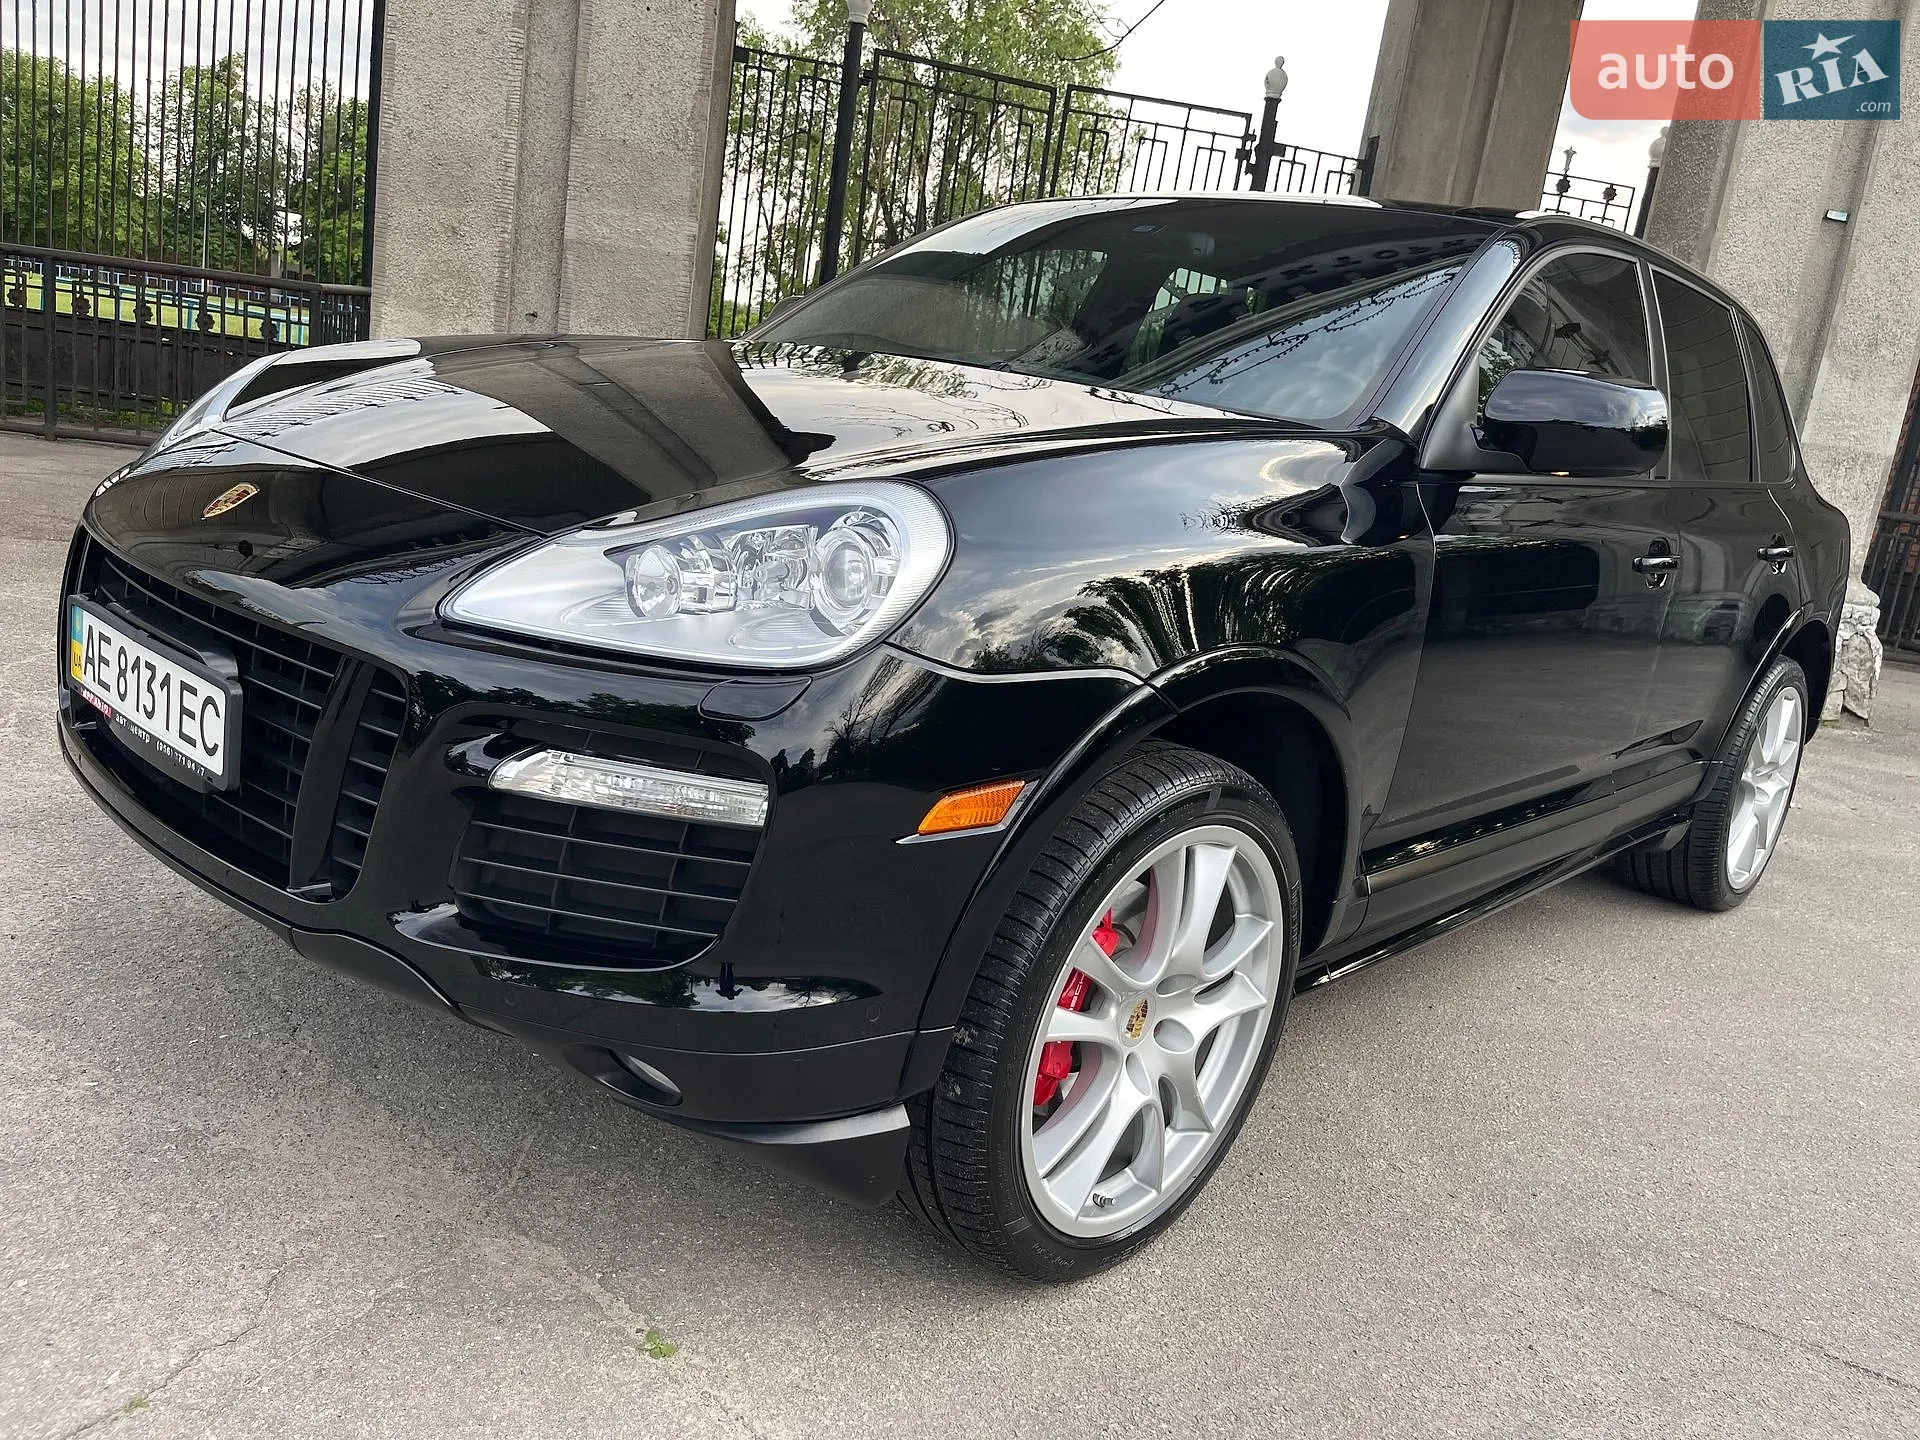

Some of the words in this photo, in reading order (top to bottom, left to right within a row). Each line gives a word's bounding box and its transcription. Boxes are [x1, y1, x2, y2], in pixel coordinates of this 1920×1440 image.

[83, 624, 112, 694] AE
[116, 645, 171, 732] 8131
[178, 679, 221, 757] EC
